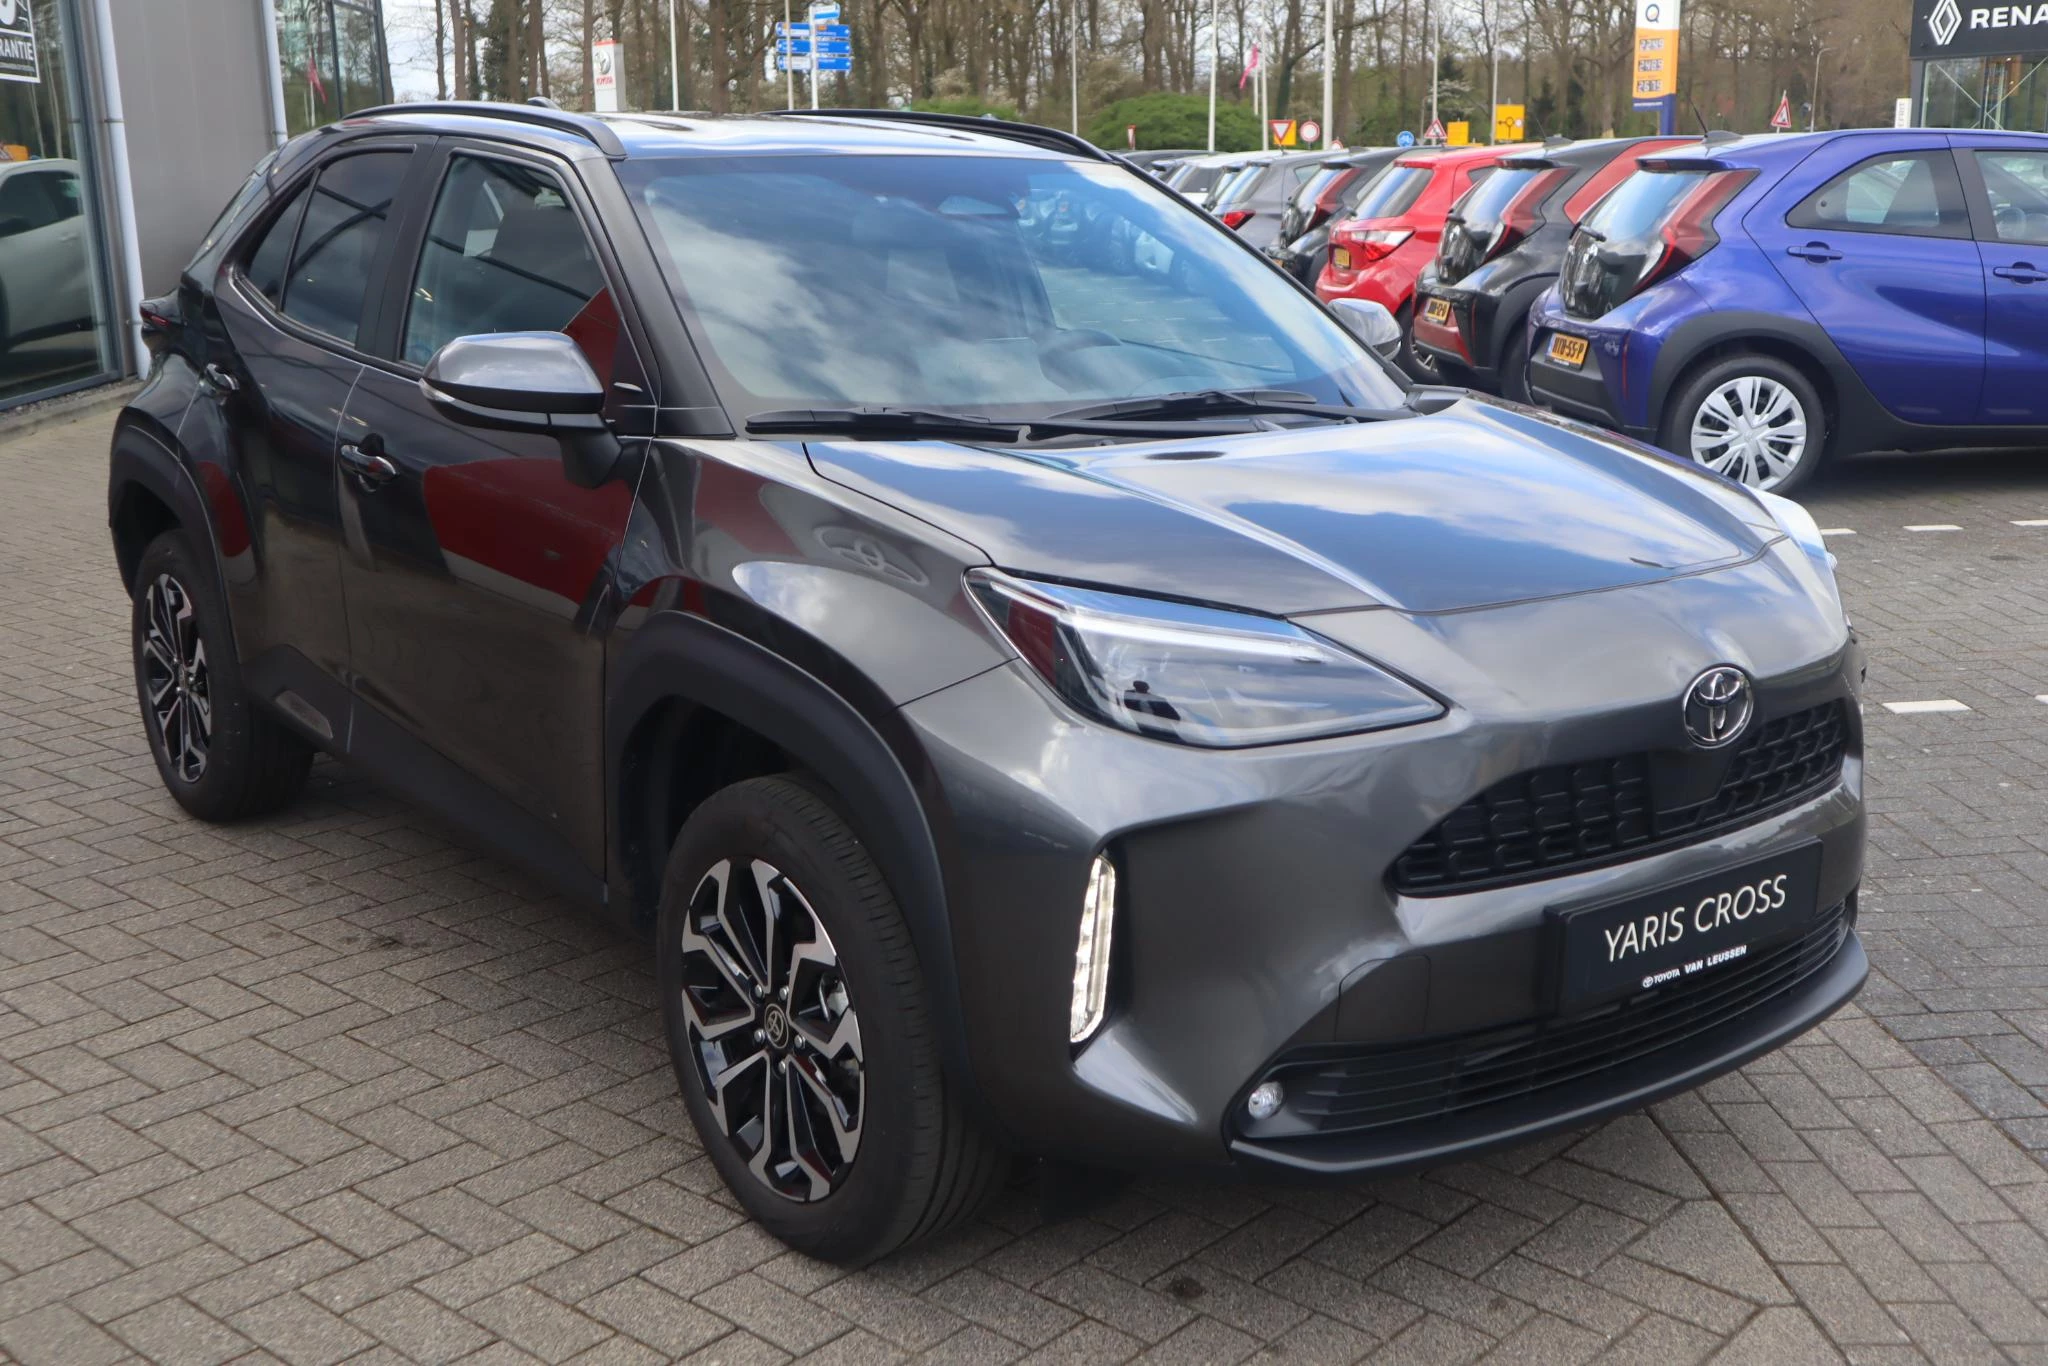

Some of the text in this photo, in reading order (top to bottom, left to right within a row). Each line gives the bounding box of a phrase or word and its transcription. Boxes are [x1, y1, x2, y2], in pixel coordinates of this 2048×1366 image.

[1604, 874, 1787, 962] YARIS CROSS
[1653, 945, 1747, 984] TOYOTA VAN LEUSSEN
